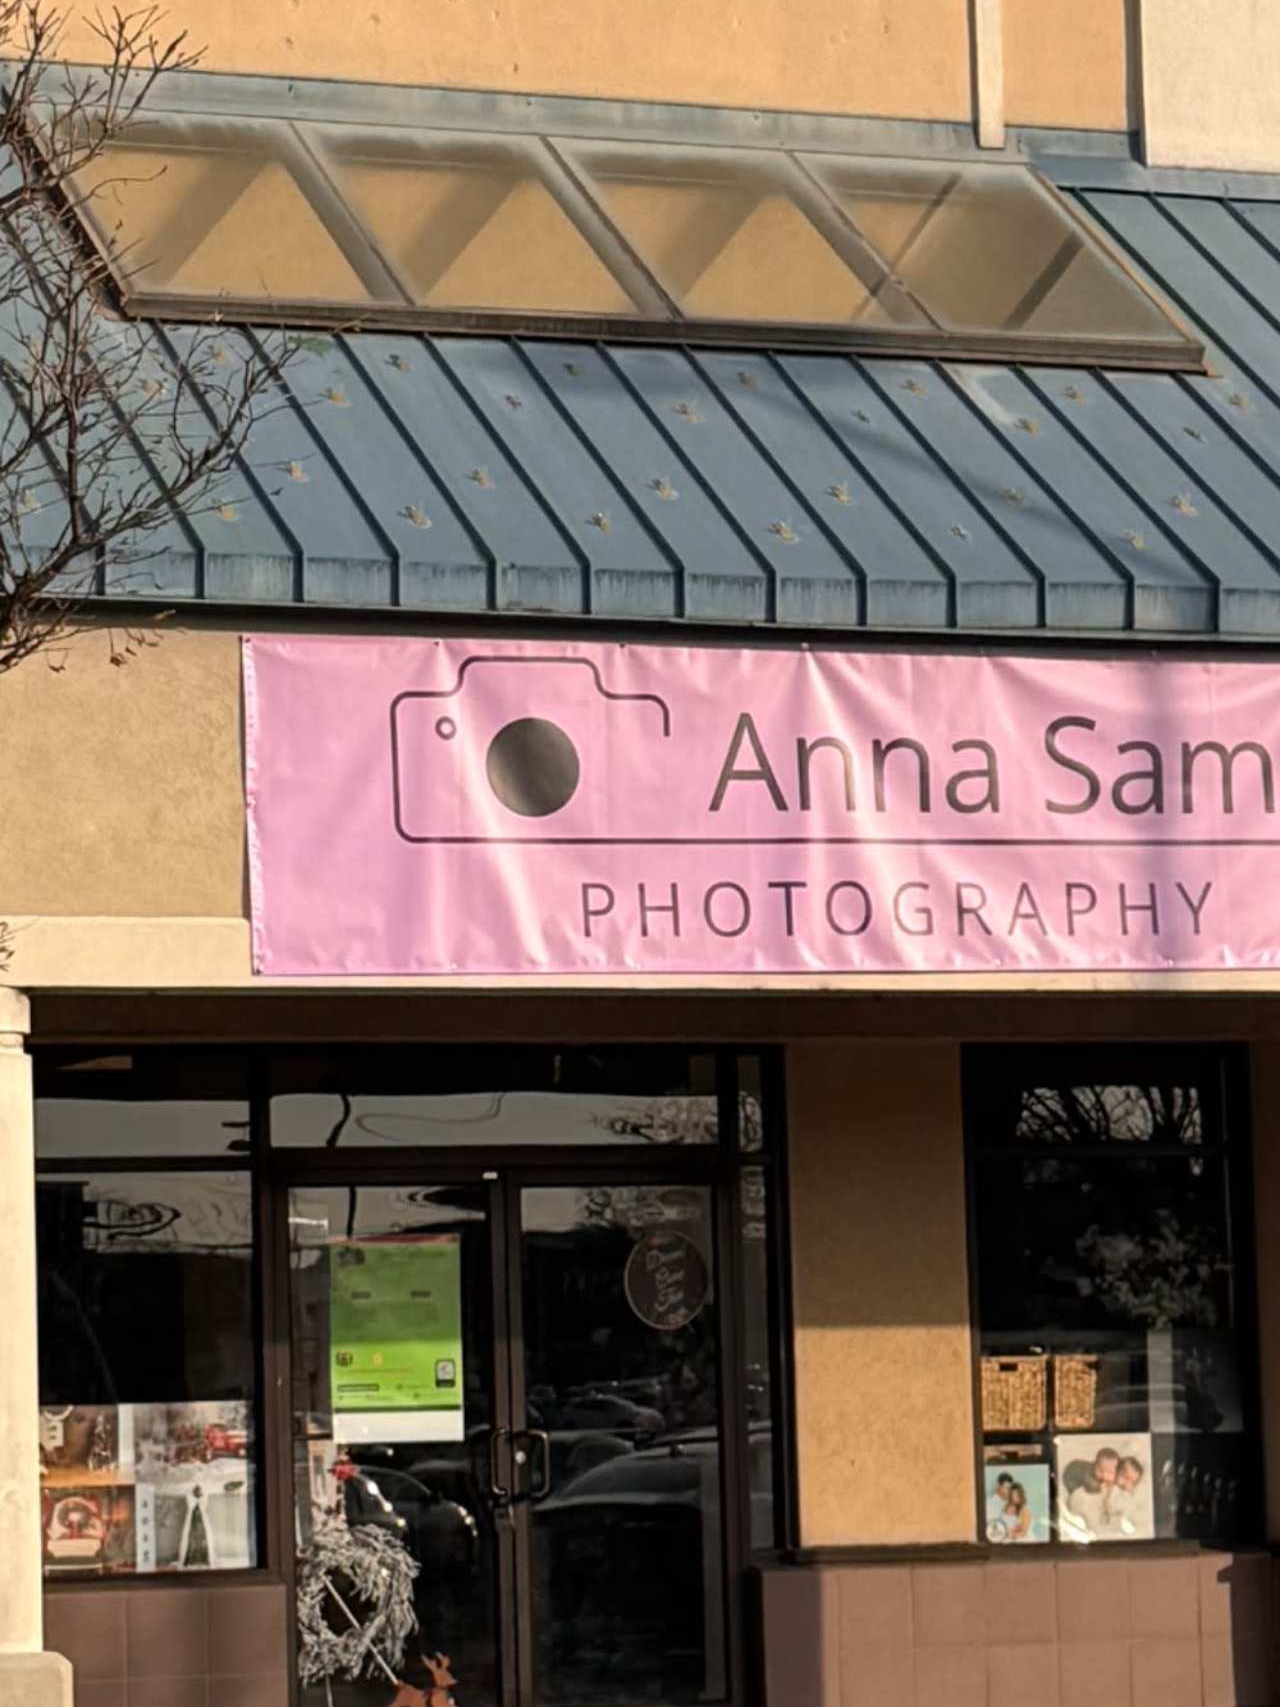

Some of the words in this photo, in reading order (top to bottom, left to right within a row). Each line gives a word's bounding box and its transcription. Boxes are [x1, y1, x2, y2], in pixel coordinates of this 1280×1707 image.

[707, 711, 1001, 815] Anna
[1043, 714, 1277, 816] Sam
[581, 879, 1214, 939] PHOTOGRAPHY
